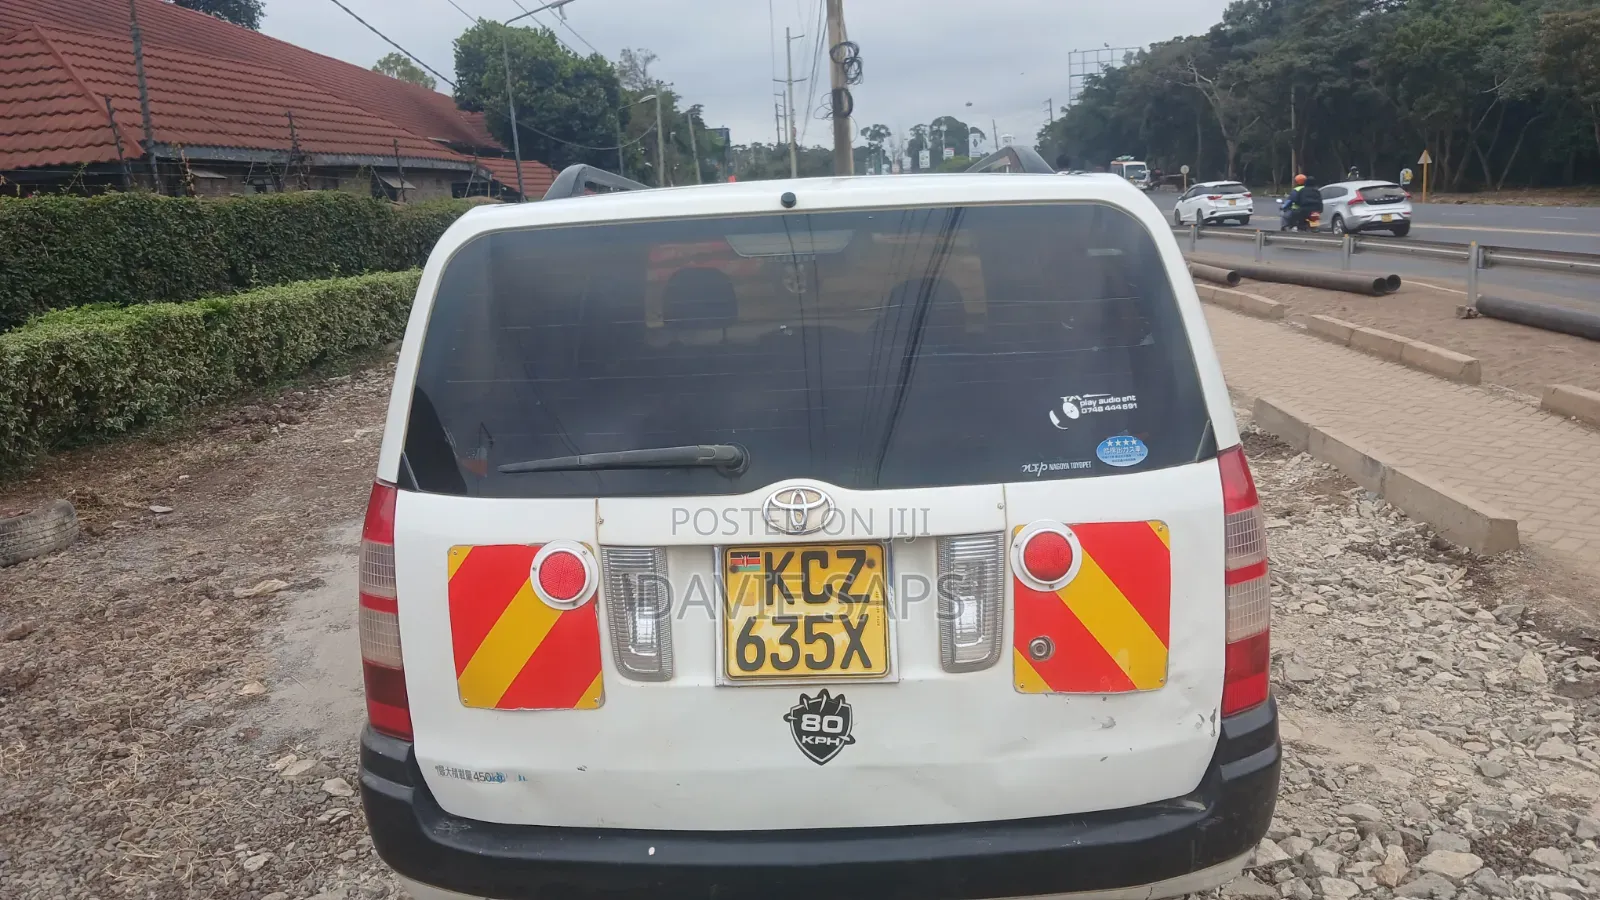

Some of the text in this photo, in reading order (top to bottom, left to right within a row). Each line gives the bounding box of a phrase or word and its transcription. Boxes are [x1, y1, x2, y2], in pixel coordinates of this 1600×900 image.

[1079, 394, 1137, 409] play audio ent
[1048, 462, 1070, 471] NAGOYA
[1070, 460, 1092, 469] TOYOPET
[764, 550, 870, 606] KCZ
[736, 614, 872, 671] 635X
[801, 713, 843, 734] 80
[801, 735, 840, 746] KPH
